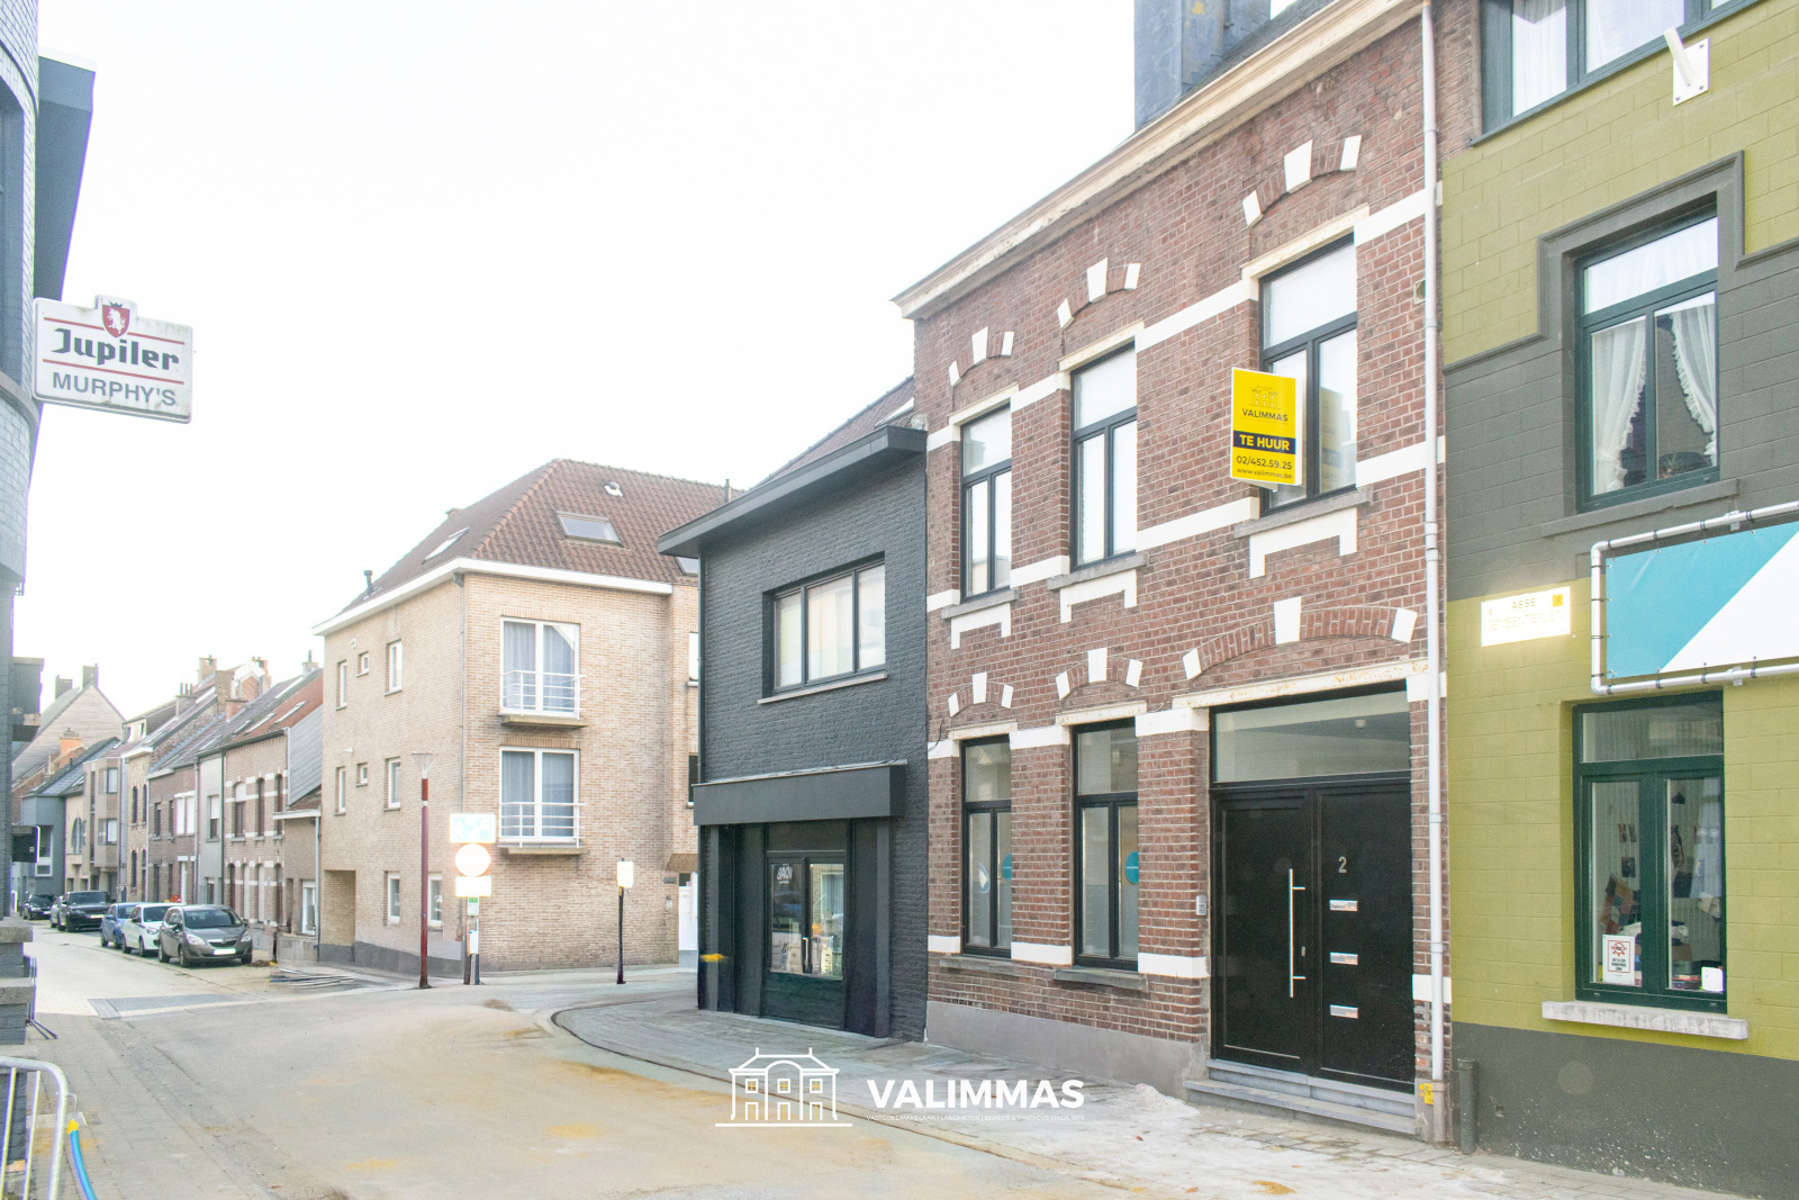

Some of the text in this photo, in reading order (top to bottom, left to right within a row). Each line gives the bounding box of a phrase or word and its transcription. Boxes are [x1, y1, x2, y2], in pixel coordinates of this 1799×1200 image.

[51, 328, 179, 370] Jupiler
[52, 372, 176, 406] MURPHY'S
[1242, 408, 1288, 422] VALIMMAS
[1239, 433, 1290, 451] TE HUUR
[1236, 455, 1292, 470] 02/452.59.25
[1236, 468, 1292, 479] www.valimmas.be
[1512, 597, 1535, 610] ASSE
[1338, 856, 1347, 873] 2
